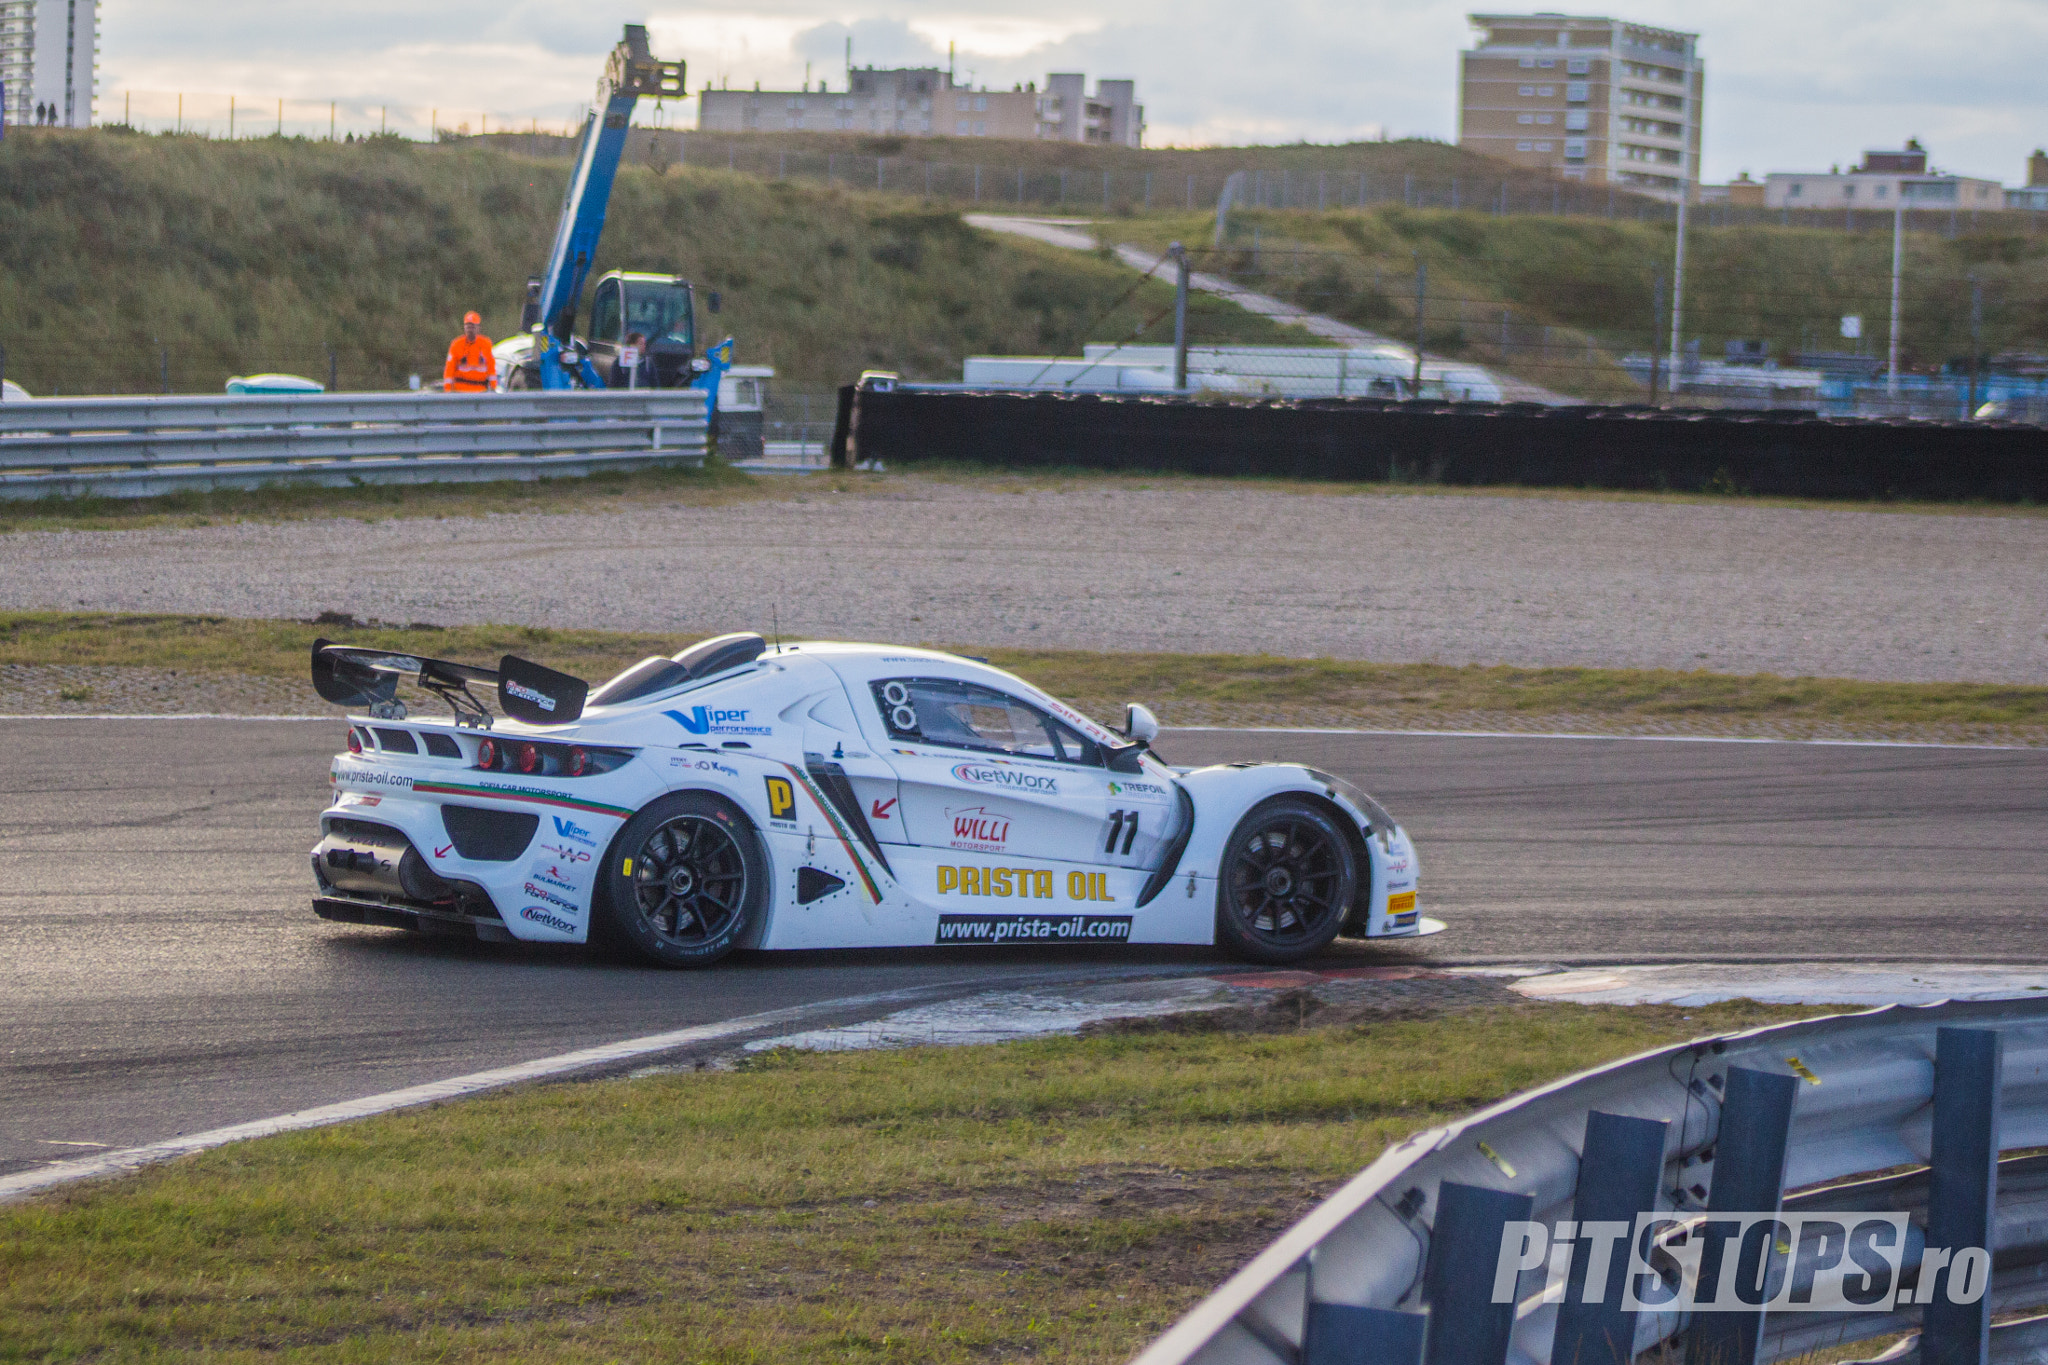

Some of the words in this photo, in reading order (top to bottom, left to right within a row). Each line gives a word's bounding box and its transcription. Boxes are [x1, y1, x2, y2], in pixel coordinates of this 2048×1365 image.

[661, 705, 750, 735] Viper
[336, 770, 413, 788] www.prista-oil.com
[963, 767, 1057, 790] NetWorx
[1121, 782, 1166, 794] TREFOIL
[519, 786, 573, 799] MOTORSPORT
[954, 816, 1010, 842] WILLI
[1105, 809, 1139, 856] 11
[950, 840, 1006, 852] MOTORSPORT
[533, 873, 577, 892] BULMARKET
[937, 865, 1053, 899] PRISTA
[1067, 871, 1116, 902] OIL
[525, 909, 577, 932] NetWorx
[939, 917, 1130, 943] www.prista-oil.com
